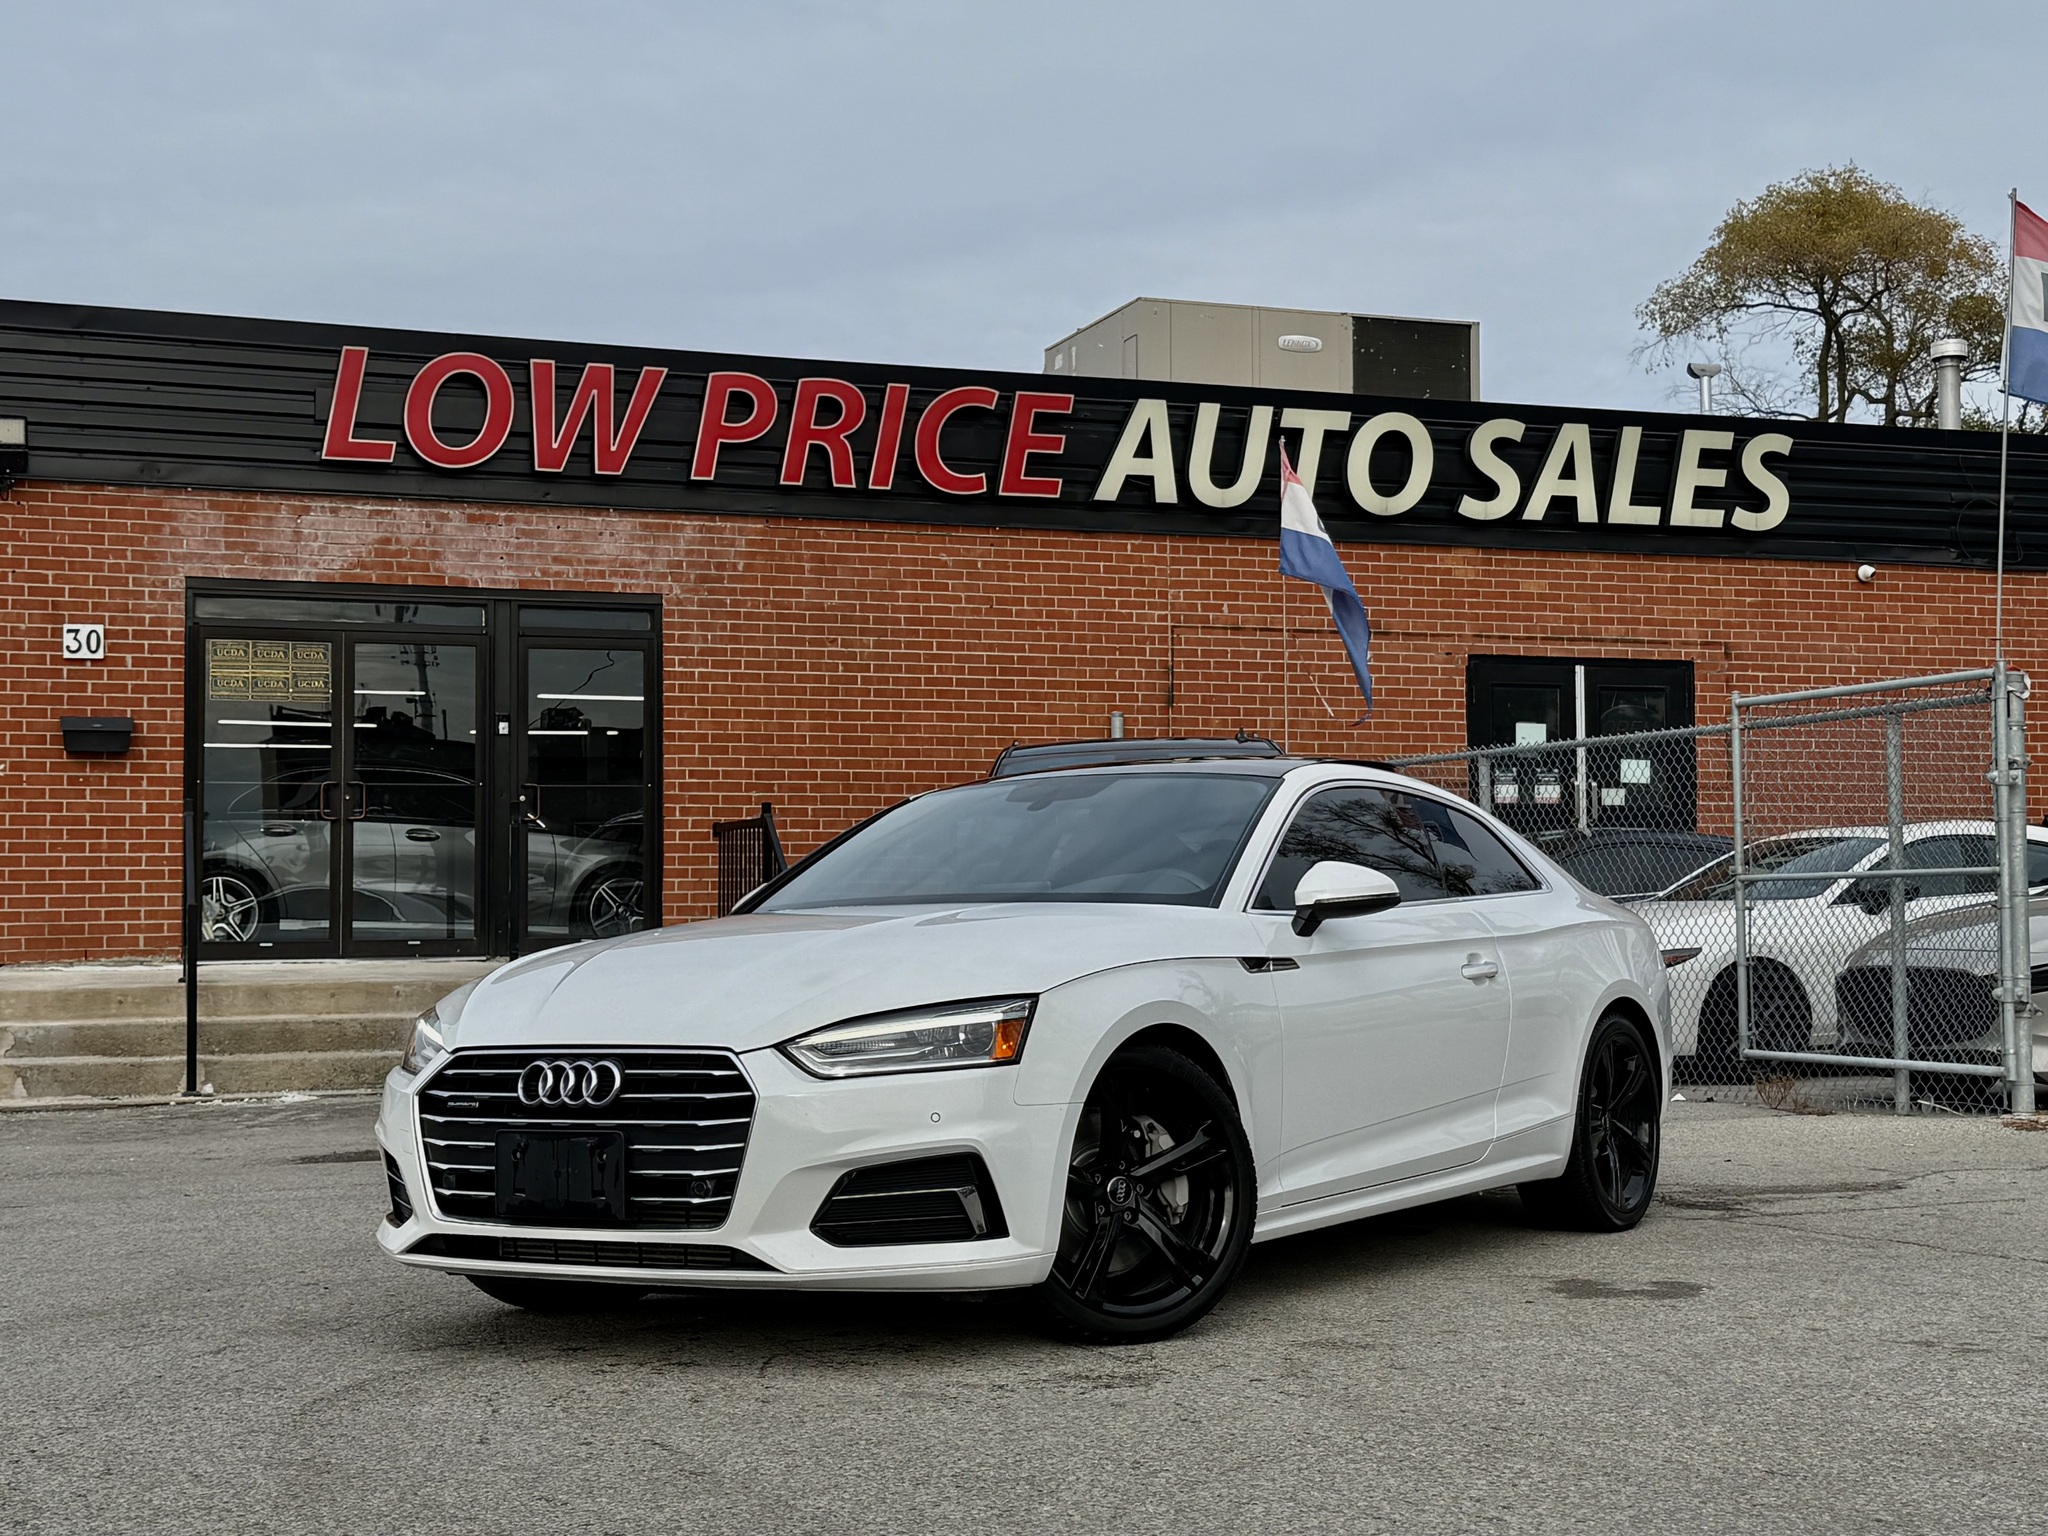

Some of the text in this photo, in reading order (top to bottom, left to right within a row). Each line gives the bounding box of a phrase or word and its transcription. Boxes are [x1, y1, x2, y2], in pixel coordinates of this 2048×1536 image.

[321, 346, 1794, 532] LOW PRICE AUTO SALES
[65, 628, 101, 654] 30
[216, 648, 245, 657] UCDA
[256, 649, 285, 659] UCDA
[296, 651, 325, 660] UCDA
[216, 679, 244, 688] UCDA
[256, 680, 284, 688] UCDA
[297, 680, 325, 688] UCDA
